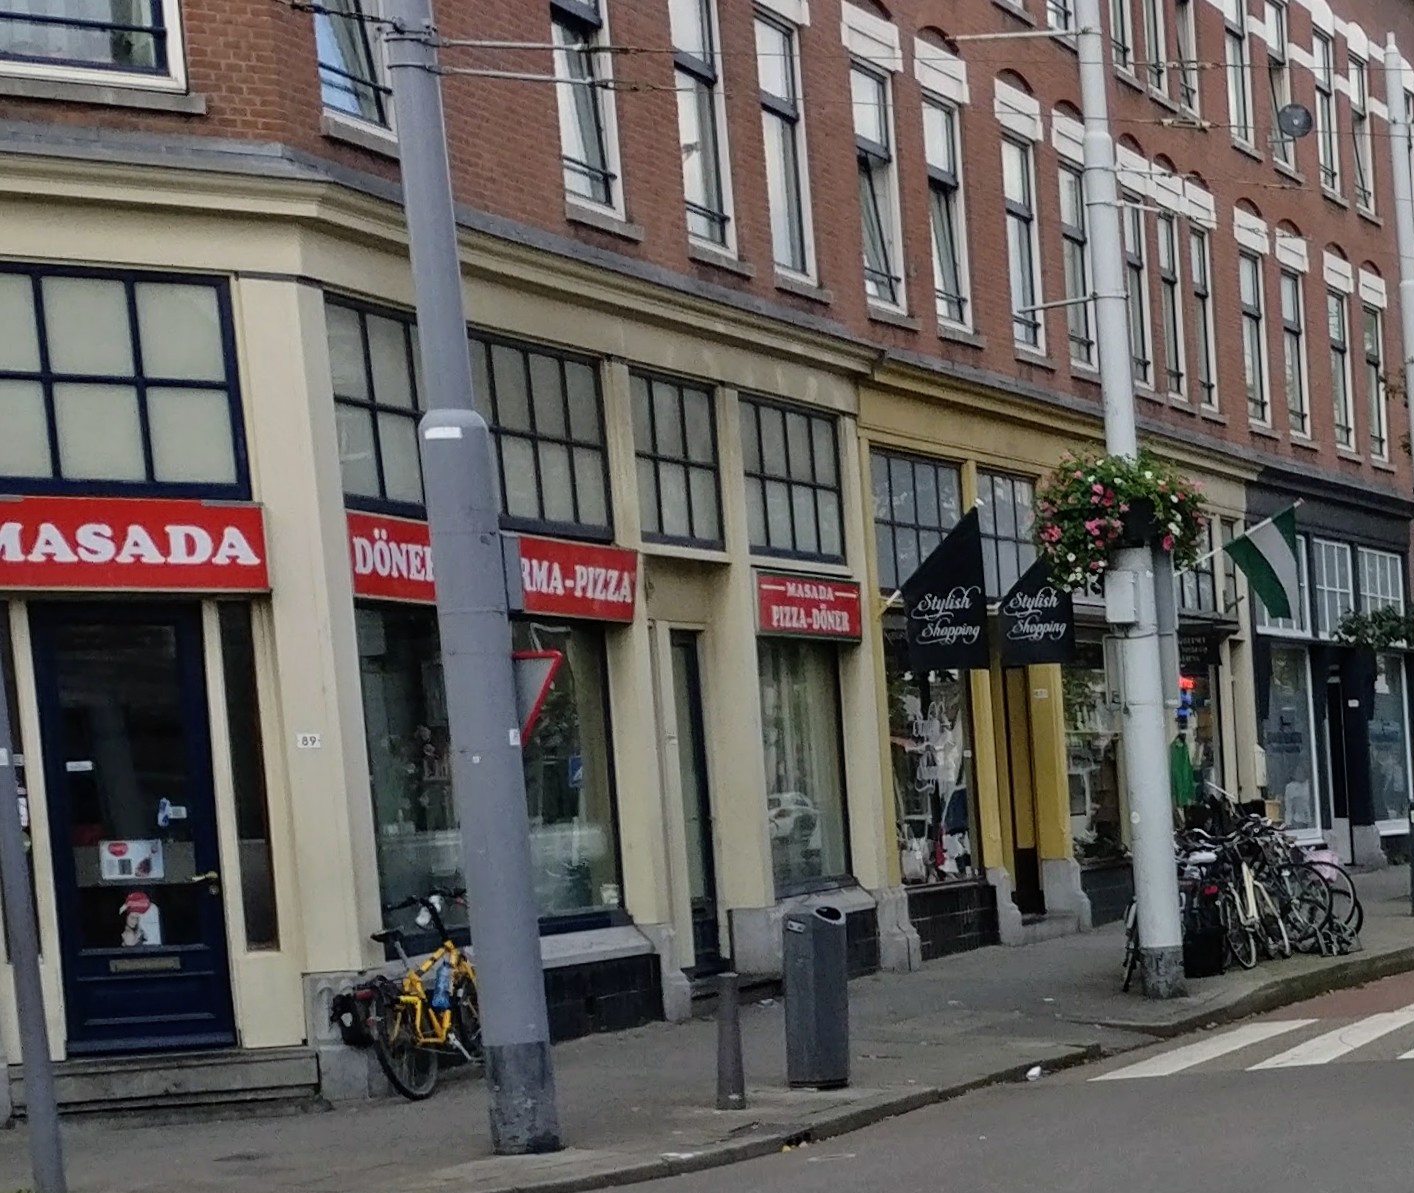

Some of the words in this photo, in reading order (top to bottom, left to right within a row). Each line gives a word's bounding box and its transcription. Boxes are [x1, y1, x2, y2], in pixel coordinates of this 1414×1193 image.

[520, 557, 634, 604] RMA-PIZZA
[786, 582, 835, 602] MASADA
[911, 585, 982, 620] Stylish
[1003, 585, 1060, 618] Stylish
[771, 603, 850, 632] PIZZA-DÖNER
[916, 617, 981, 646] Shopping
[1006, 614, 1068, 641] Shopping
